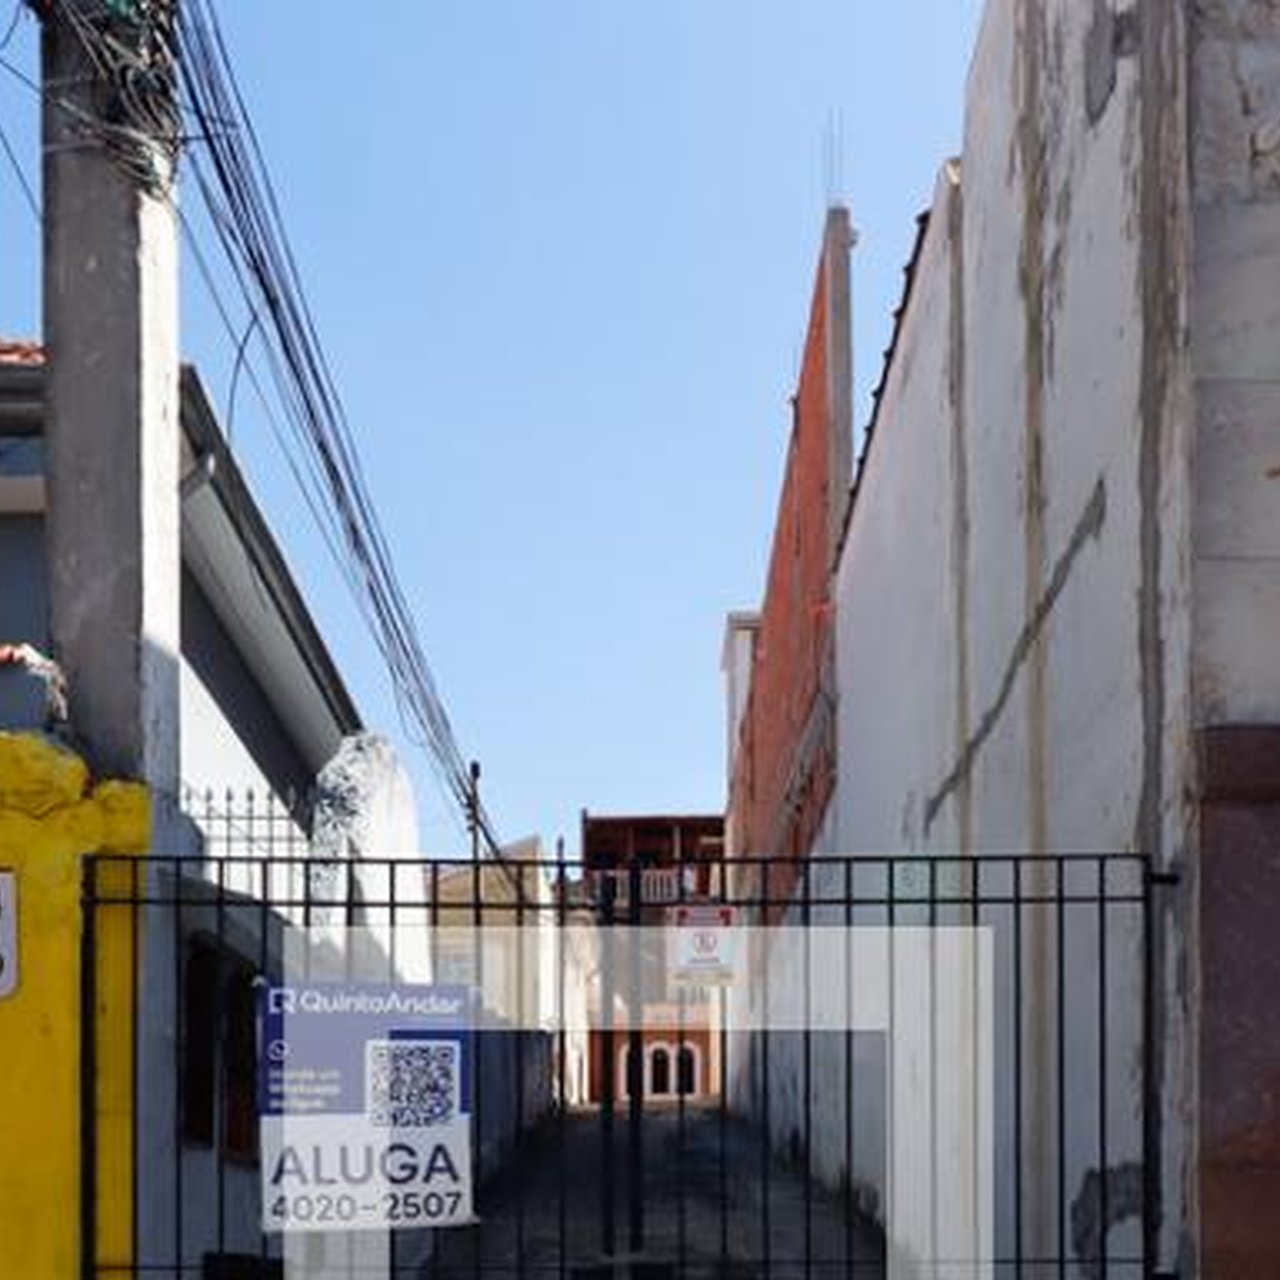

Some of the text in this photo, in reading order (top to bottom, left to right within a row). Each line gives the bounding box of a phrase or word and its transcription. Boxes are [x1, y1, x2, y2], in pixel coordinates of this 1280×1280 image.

[299, 989, 460, 1015] QuintoAndar
[271, 1144, 460, 1185] ALUGA
[272, 1193, 462, 1221] 4020-2507
